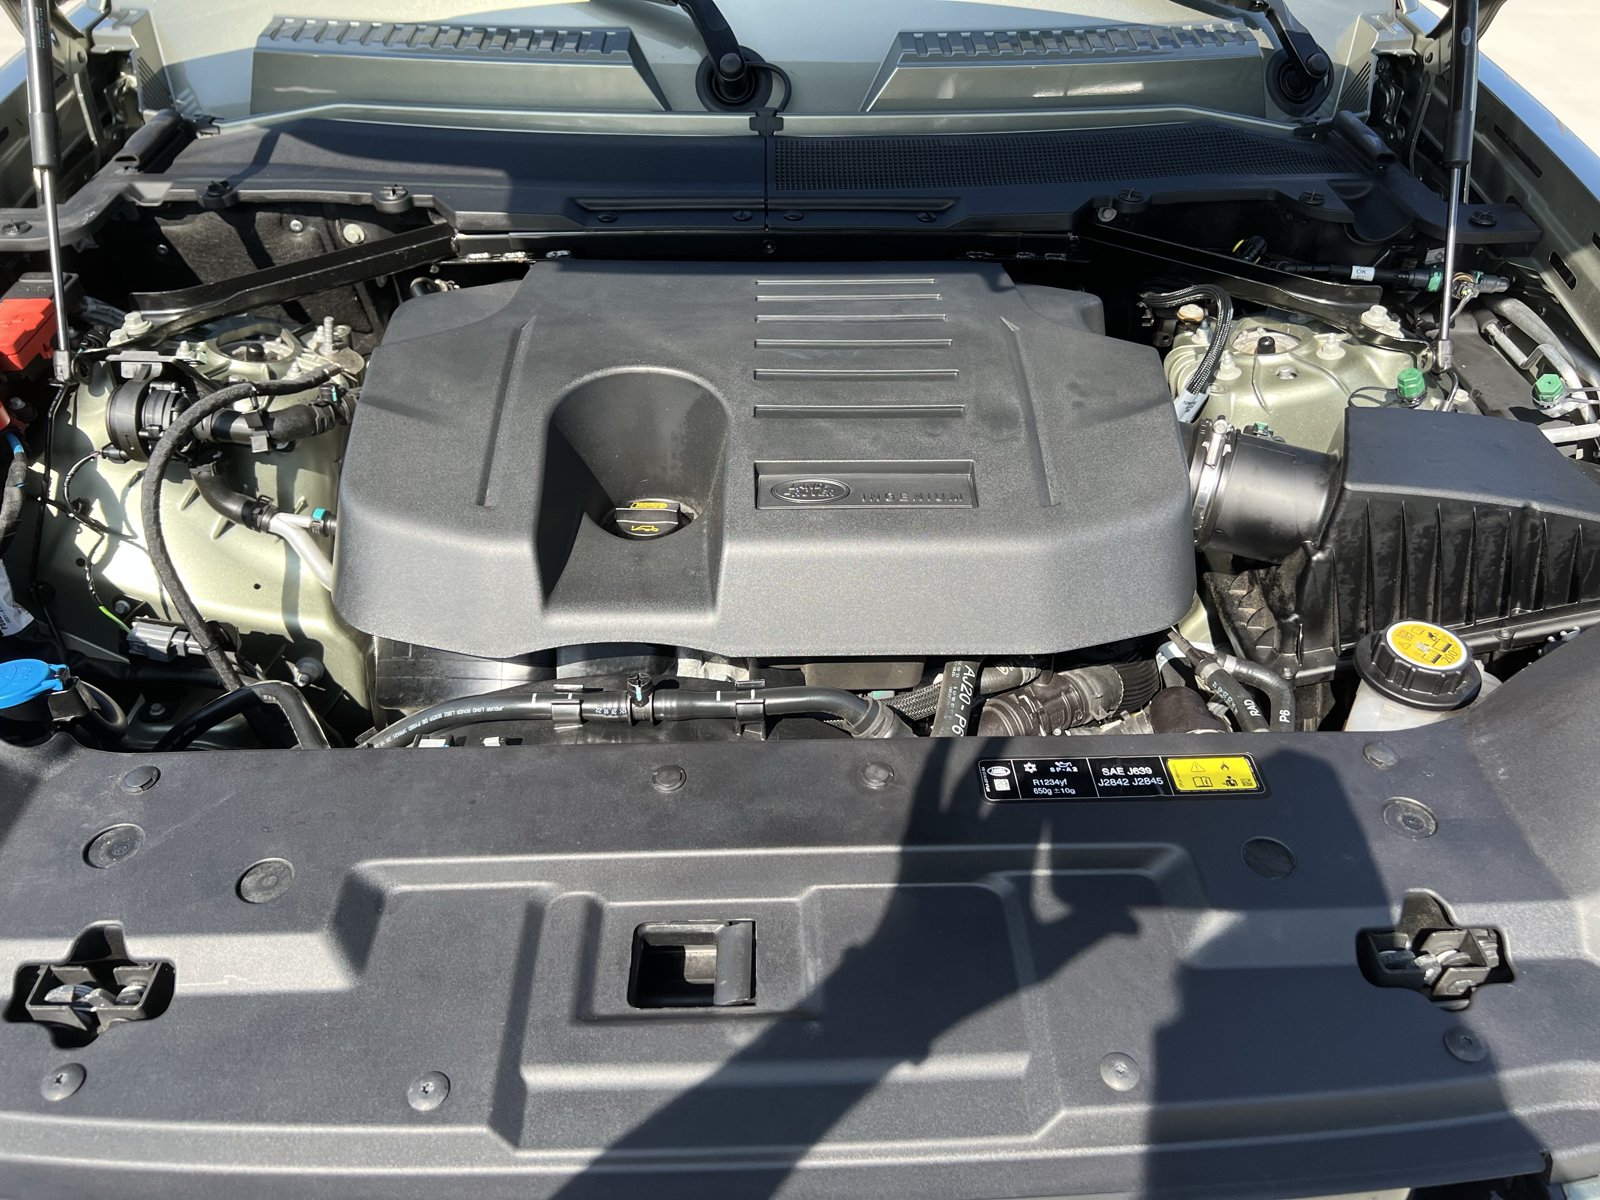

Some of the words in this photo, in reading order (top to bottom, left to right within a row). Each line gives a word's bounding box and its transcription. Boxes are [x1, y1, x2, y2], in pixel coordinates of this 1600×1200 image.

[861, 492, 963, 503] INGENIUM
[958, 665, 976, 705] AJ20
[1243, 699, 1262, 717] RAD
[1101, 767, 1125, 776] SAE
[1126, 766, 1153, 775] J639
[1032, 778, 1068, 787] R1234yf
[1097, 778, 1130, 787] J2842
[1131, 777, 1164, 786] J2845
[1033, 787, 1053, 796] 650g
